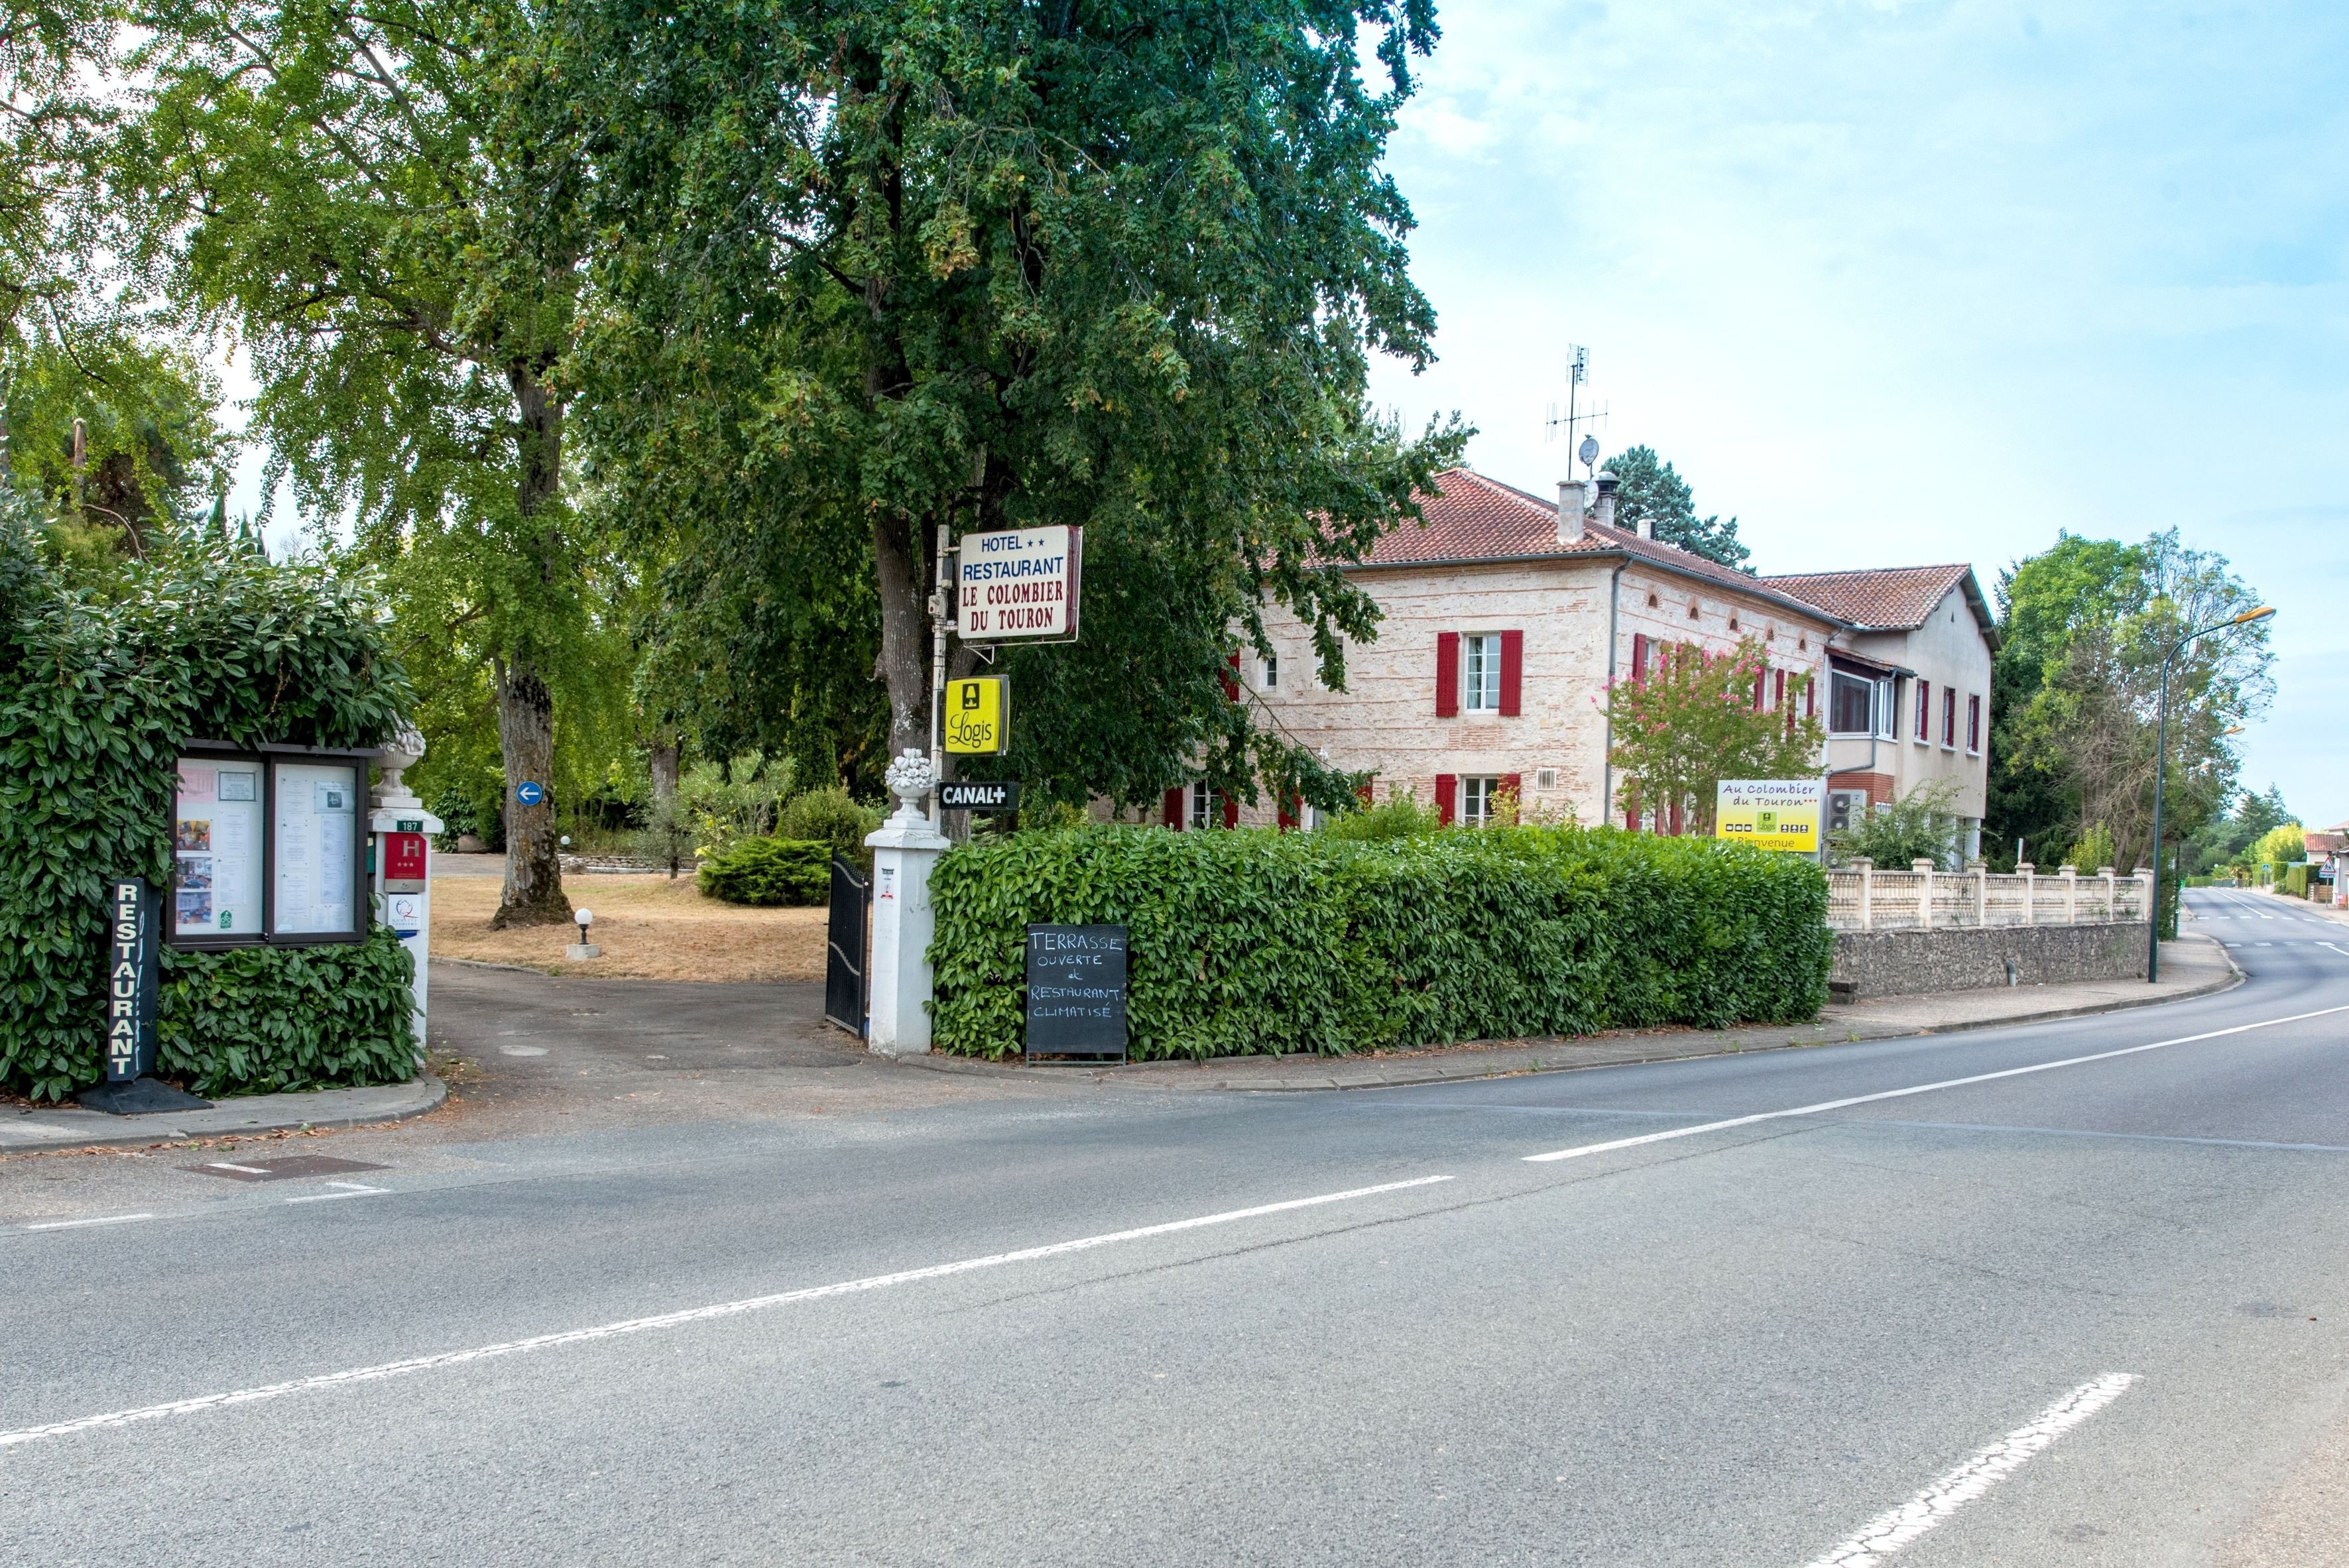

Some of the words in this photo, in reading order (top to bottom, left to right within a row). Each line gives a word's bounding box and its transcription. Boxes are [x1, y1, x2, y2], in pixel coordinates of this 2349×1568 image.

[982, 536, 1022, 552] HOTEL
[963, 557, 1063, 581] RESTAURANT
[963, 586, 977, 607] LE
[987, 581, 1063, 605] COLOMBIER
[971, 611, 989, 631] DU
[998, 607, 1054, 630] TOURON
[948, 711, 992, 749] Logis
[942, 786, 1006, 806] CANAL+
[1723, 785, 1741, 794] Au
[1747, 784, 1815, 794] Colombier
[1733, 796, 1750, 806] du
[1755, 798, 1803, 806] Touron
[403, 822, 418, 831] 187
[402, 840, 420, 857] H
[1738, 837, 1795, 847] Bnvenue
[1030, 932, 1122, 950] TERRASSE
[1038, 955, 1102, 966] OUVERTE
[110, 884, 138, 1074] RESTAURANT
[1068, 969, 1083, 980] et
[1031, 985, 1119, 1001] RESTAURANT
